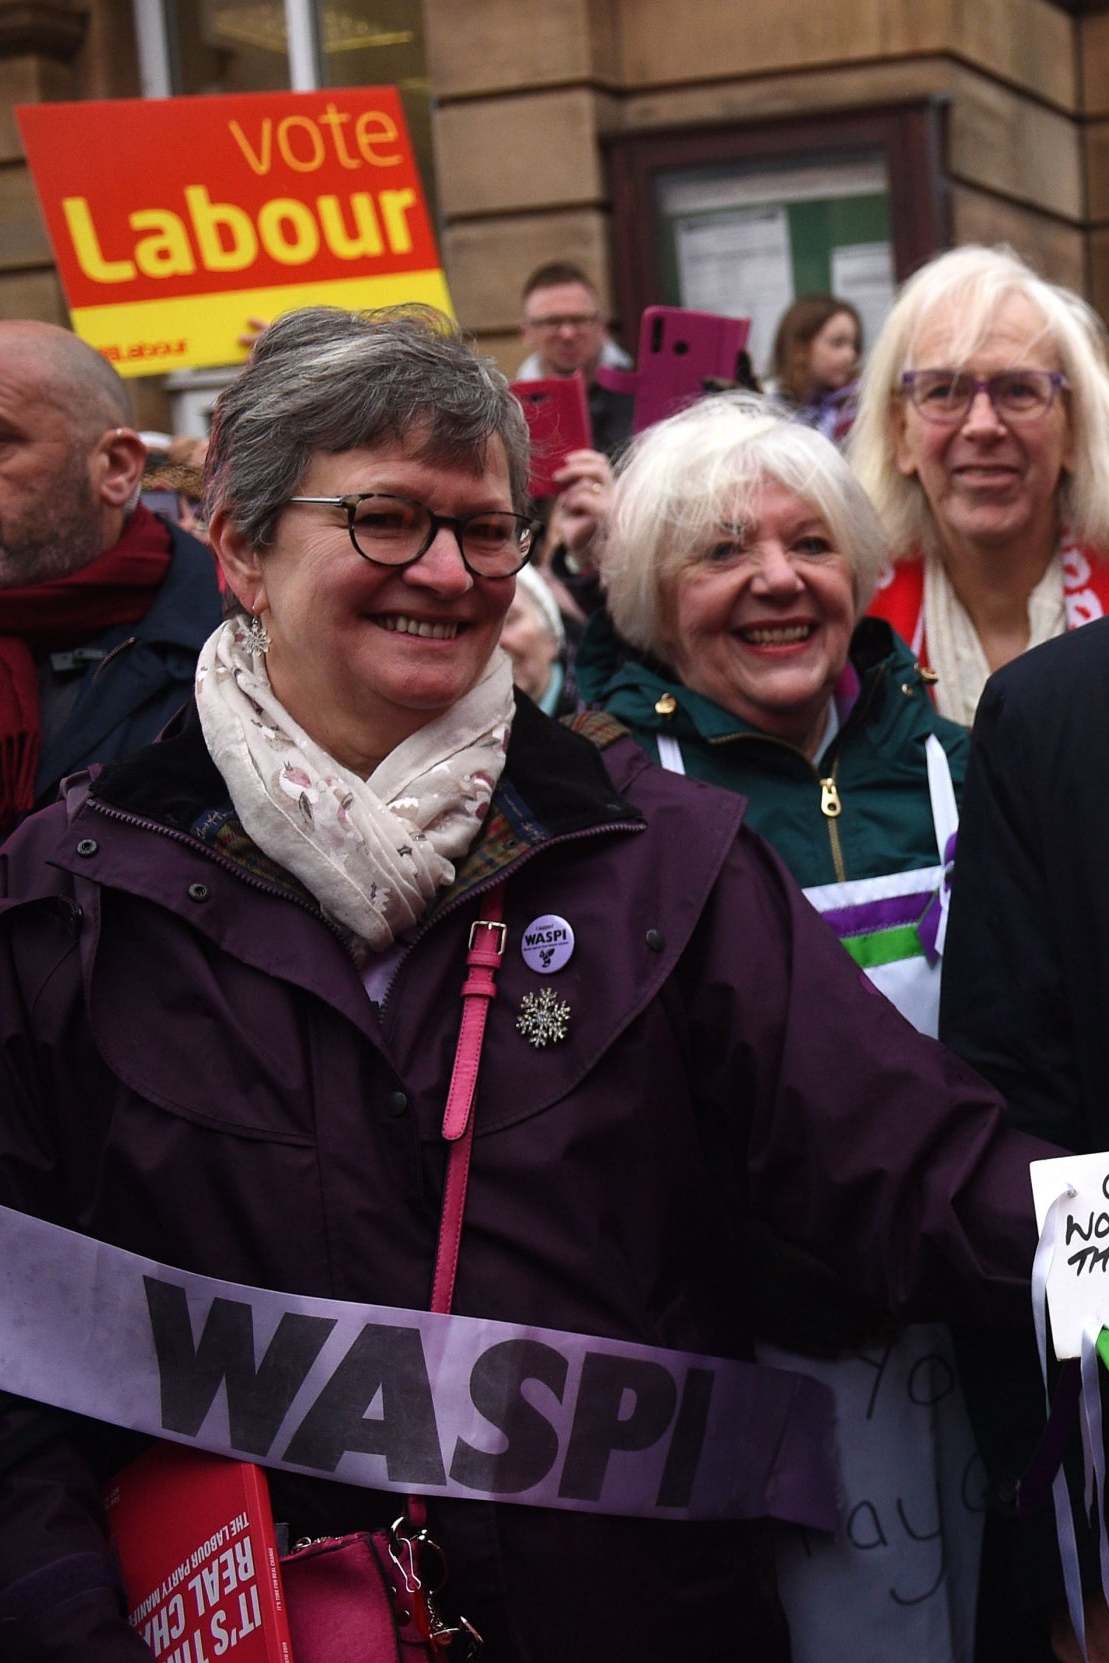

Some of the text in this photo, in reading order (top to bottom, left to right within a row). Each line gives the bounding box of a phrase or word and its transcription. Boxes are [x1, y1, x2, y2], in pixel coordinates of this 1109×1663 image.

[228, 103, 402, 176] vote
[62, 185, 417, 284] Labour
[525, 928, 567, 946] WASPI
[142, 1275, 714, 1508] WASPI
[191, 1523, 230, 1569] LABOUR
[230, 1512, 250, 1536] THE
[161, 1557, 191, 1597] PARTY
[188, 1536, 255, 1617] REAL
[211, 1585, 262, 1656] IT'S
